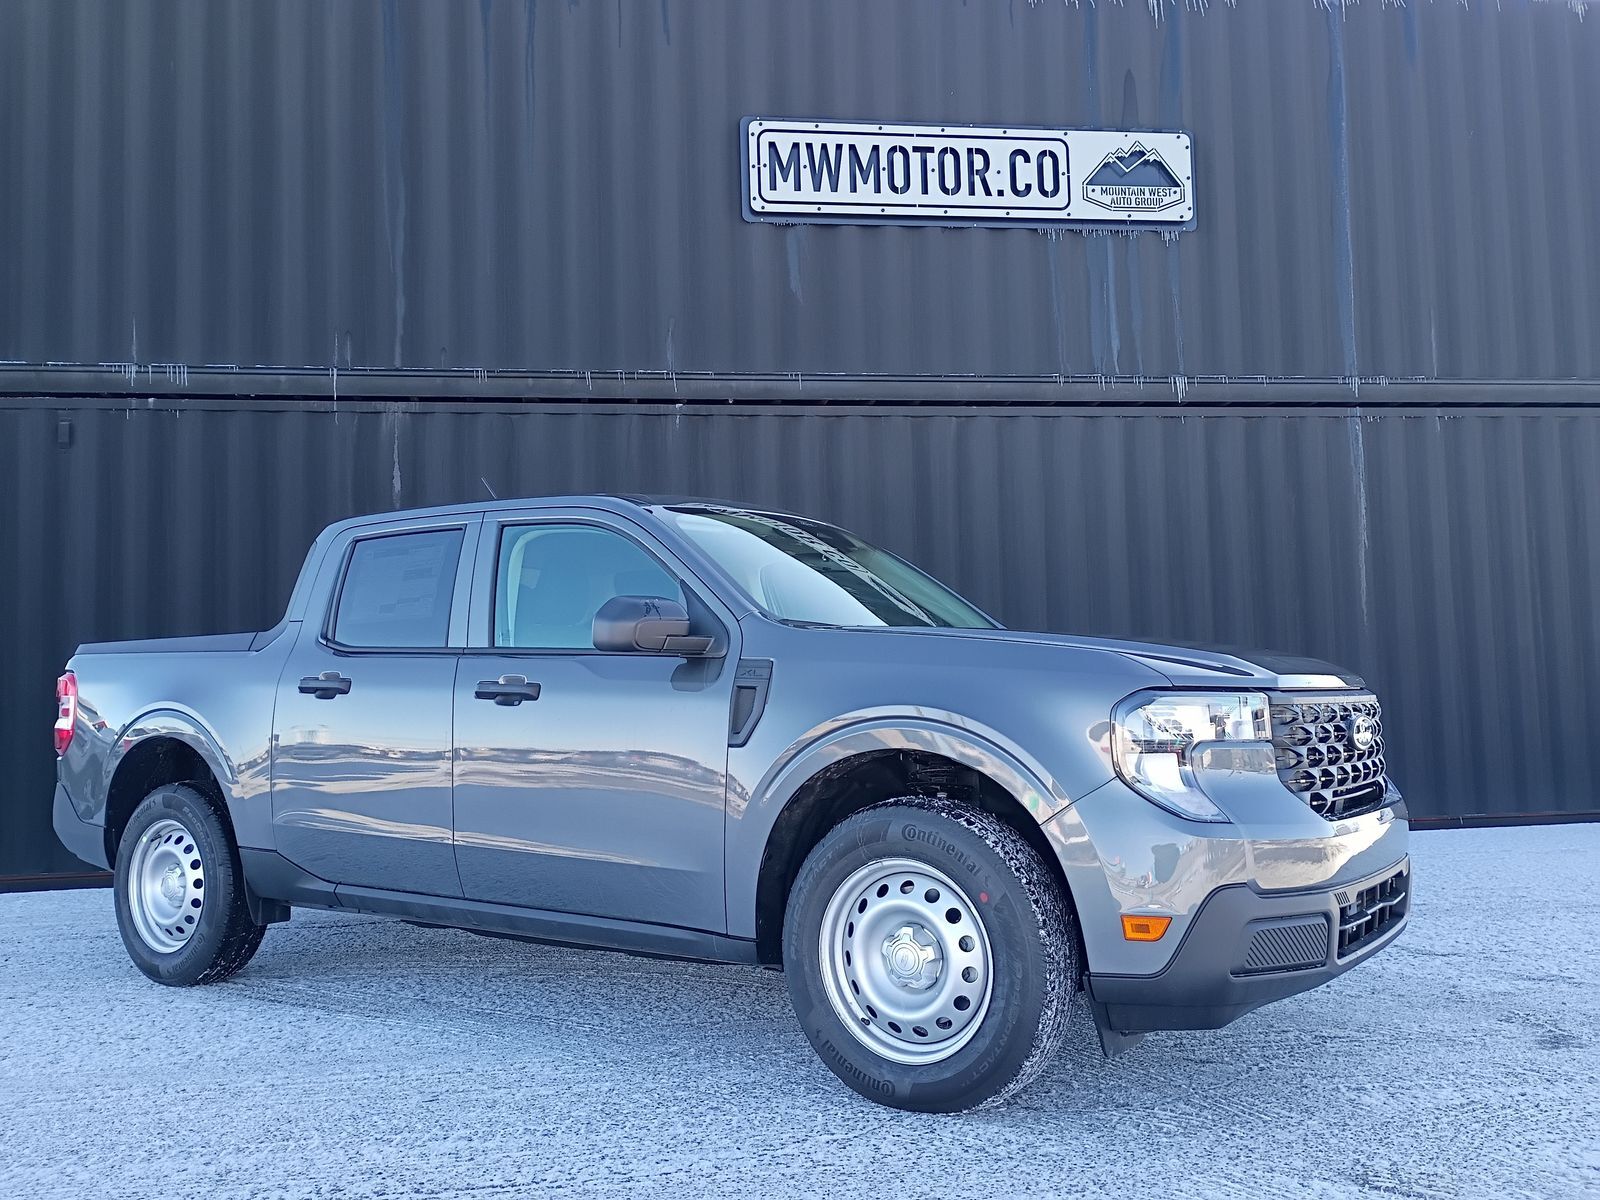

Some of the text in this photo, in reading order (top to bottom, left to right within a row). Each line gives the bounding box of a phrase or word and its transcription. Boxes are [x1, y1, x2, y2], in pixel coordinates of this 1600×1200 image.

[768, 141, 1060, 198] MWMOTOR.CO
[1100, 187, 1172, 198] MOUNTAIN WEST
[1110, 196, 1164, 207] AUTO GROUP
[901, 823, 984, 877] Continental
[821, 1040, 896, 1098] Continental
